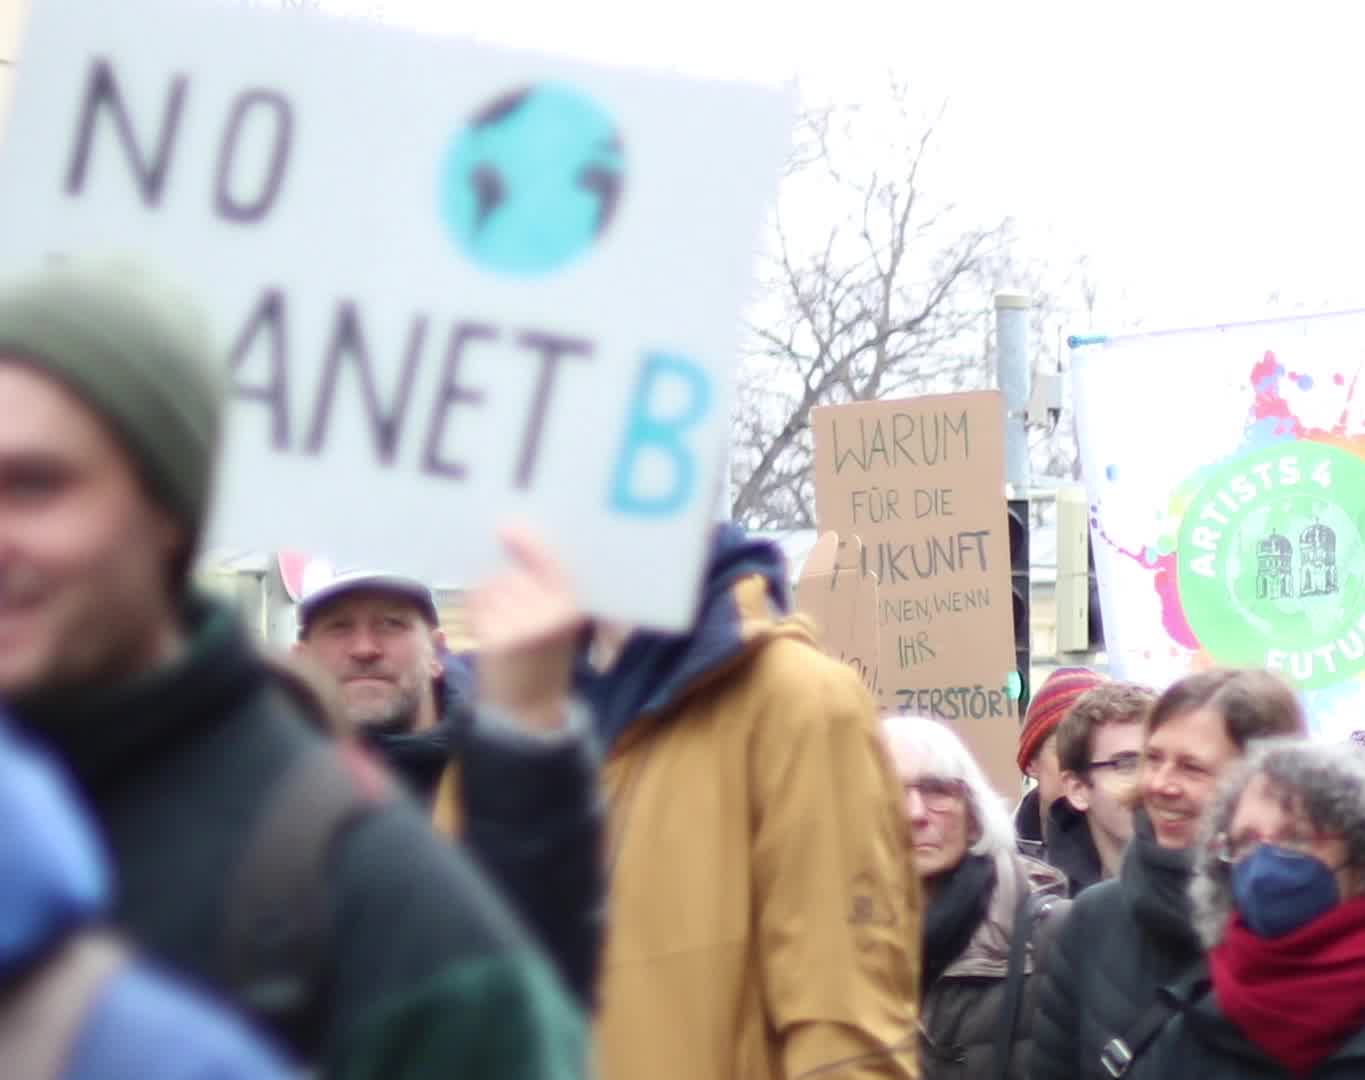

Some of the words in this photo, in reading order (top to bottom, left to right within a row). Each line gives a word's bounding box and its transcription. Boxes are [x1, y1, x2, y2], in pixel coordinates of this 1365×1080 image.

[63, 55, 296, 227] NO
[229, 285, 596, 494] ANET
[605, 348, 718, 519] B
[831, 409, 970, 476] WARUM
[851, 486, 902, 525] FÜR
[914, 488, 954, 519] DIE
[1189, 455, 1301, 577] ARTISTS
[1310, 458, 1333, 489] 4
[898, 631, 937, 670] IHR
